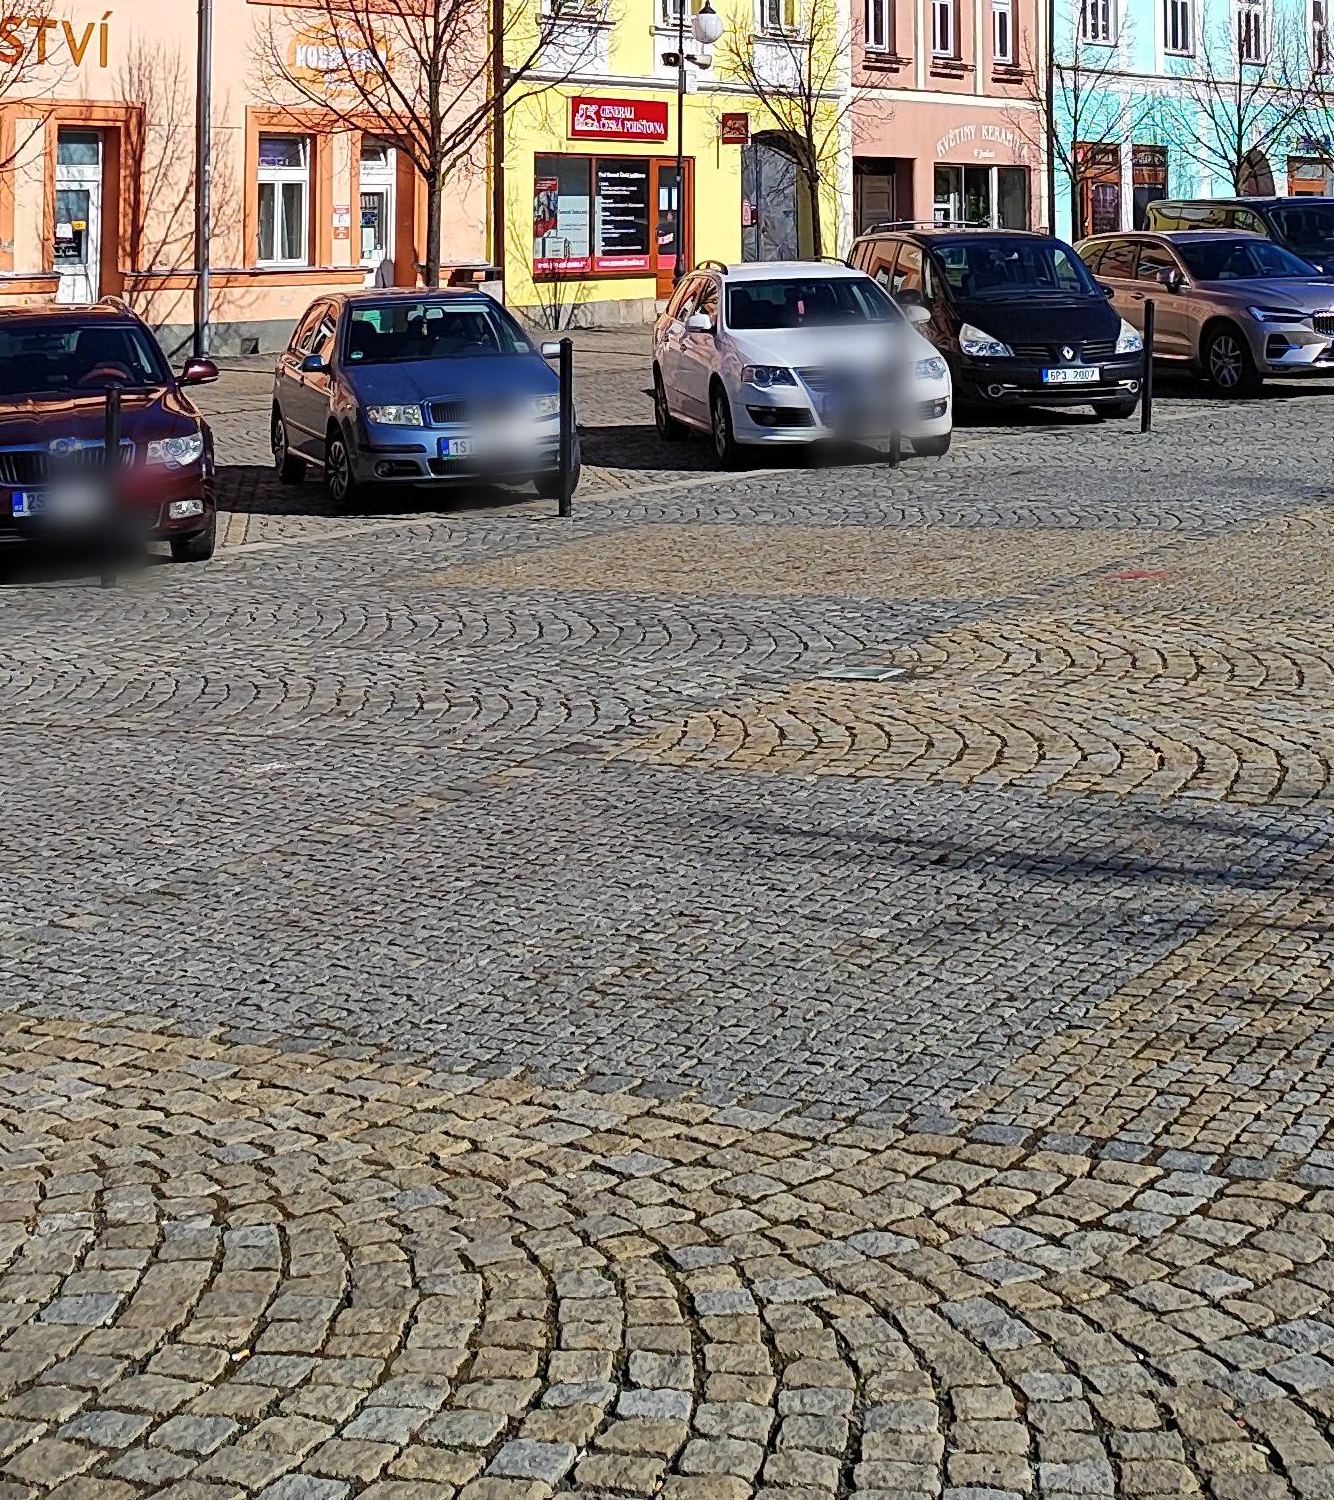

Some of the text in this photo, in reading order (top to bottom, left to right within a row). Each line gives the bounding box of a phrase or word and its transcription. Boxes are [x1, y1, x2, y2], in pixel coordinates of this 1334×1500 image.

[600, 105, 635, 119] GENERALI
[600, 117, 623, 132] ČESKÁ
[935, 124, 977, 158] KVĚTINY
